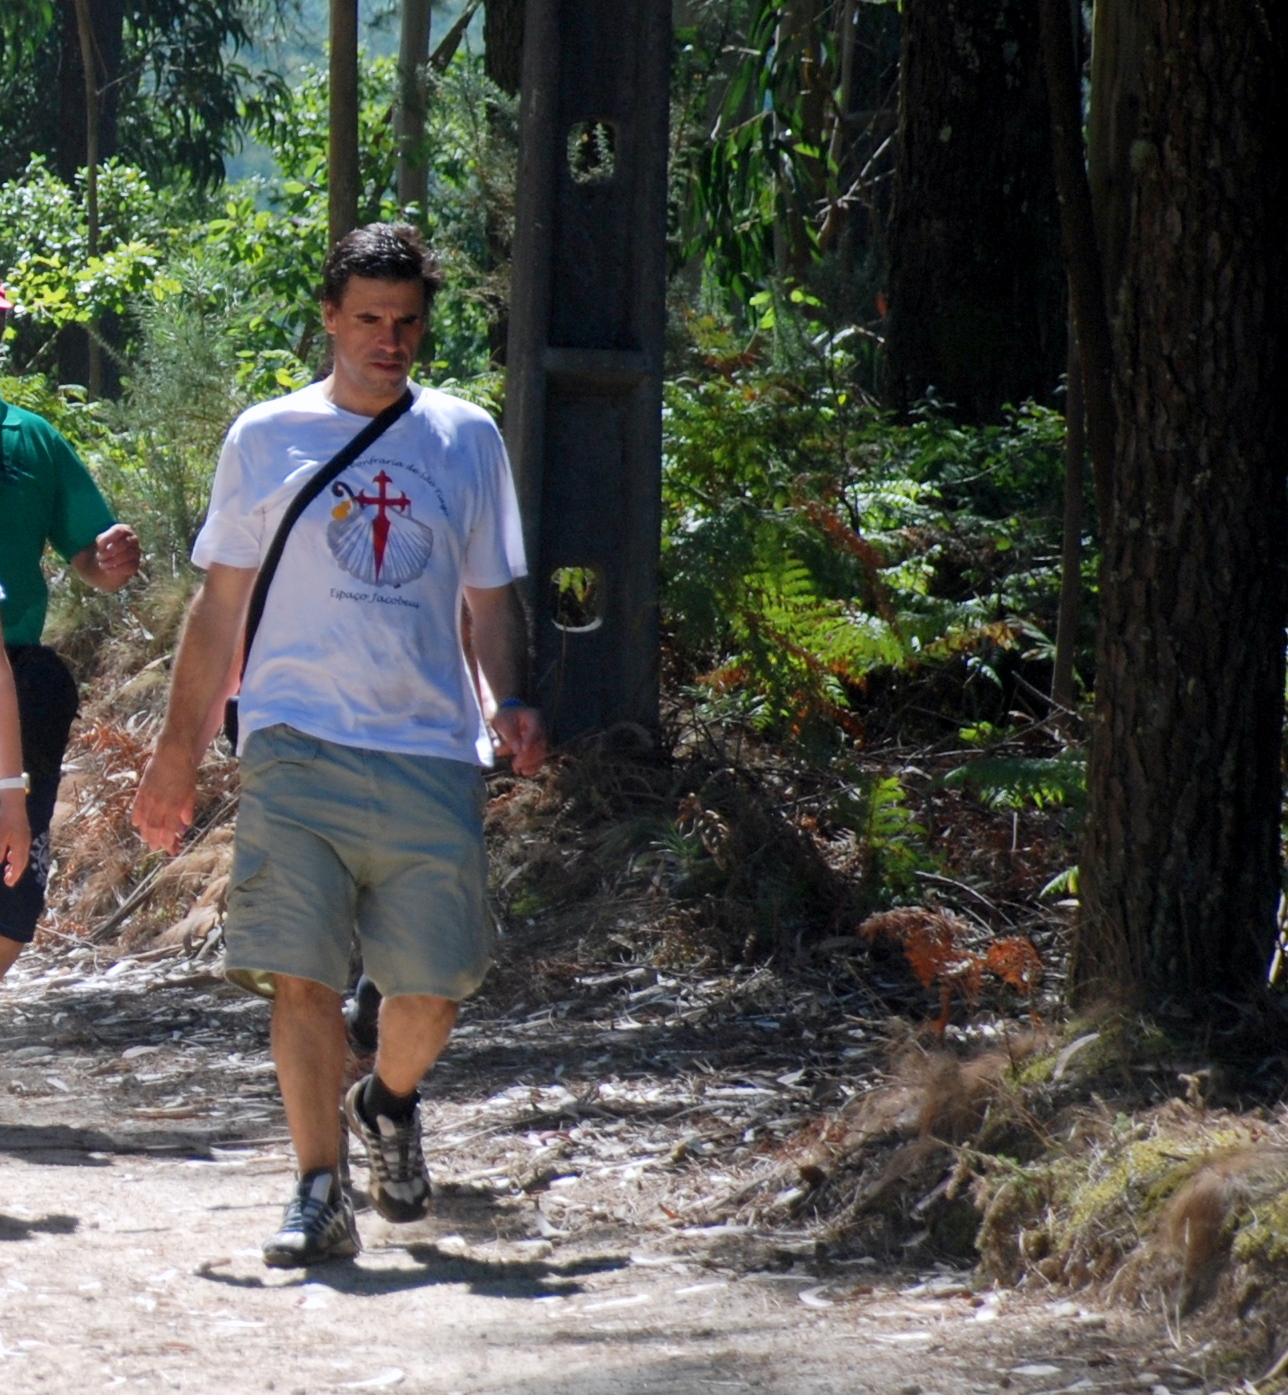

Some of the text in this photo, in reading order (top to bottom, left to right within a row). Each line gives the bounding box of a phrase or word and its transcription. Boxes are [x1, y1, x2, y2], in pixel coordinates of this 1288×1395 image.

[405, 463, 419, 474] de
[330, 587, 420, 609] Espaço Jacobeus
